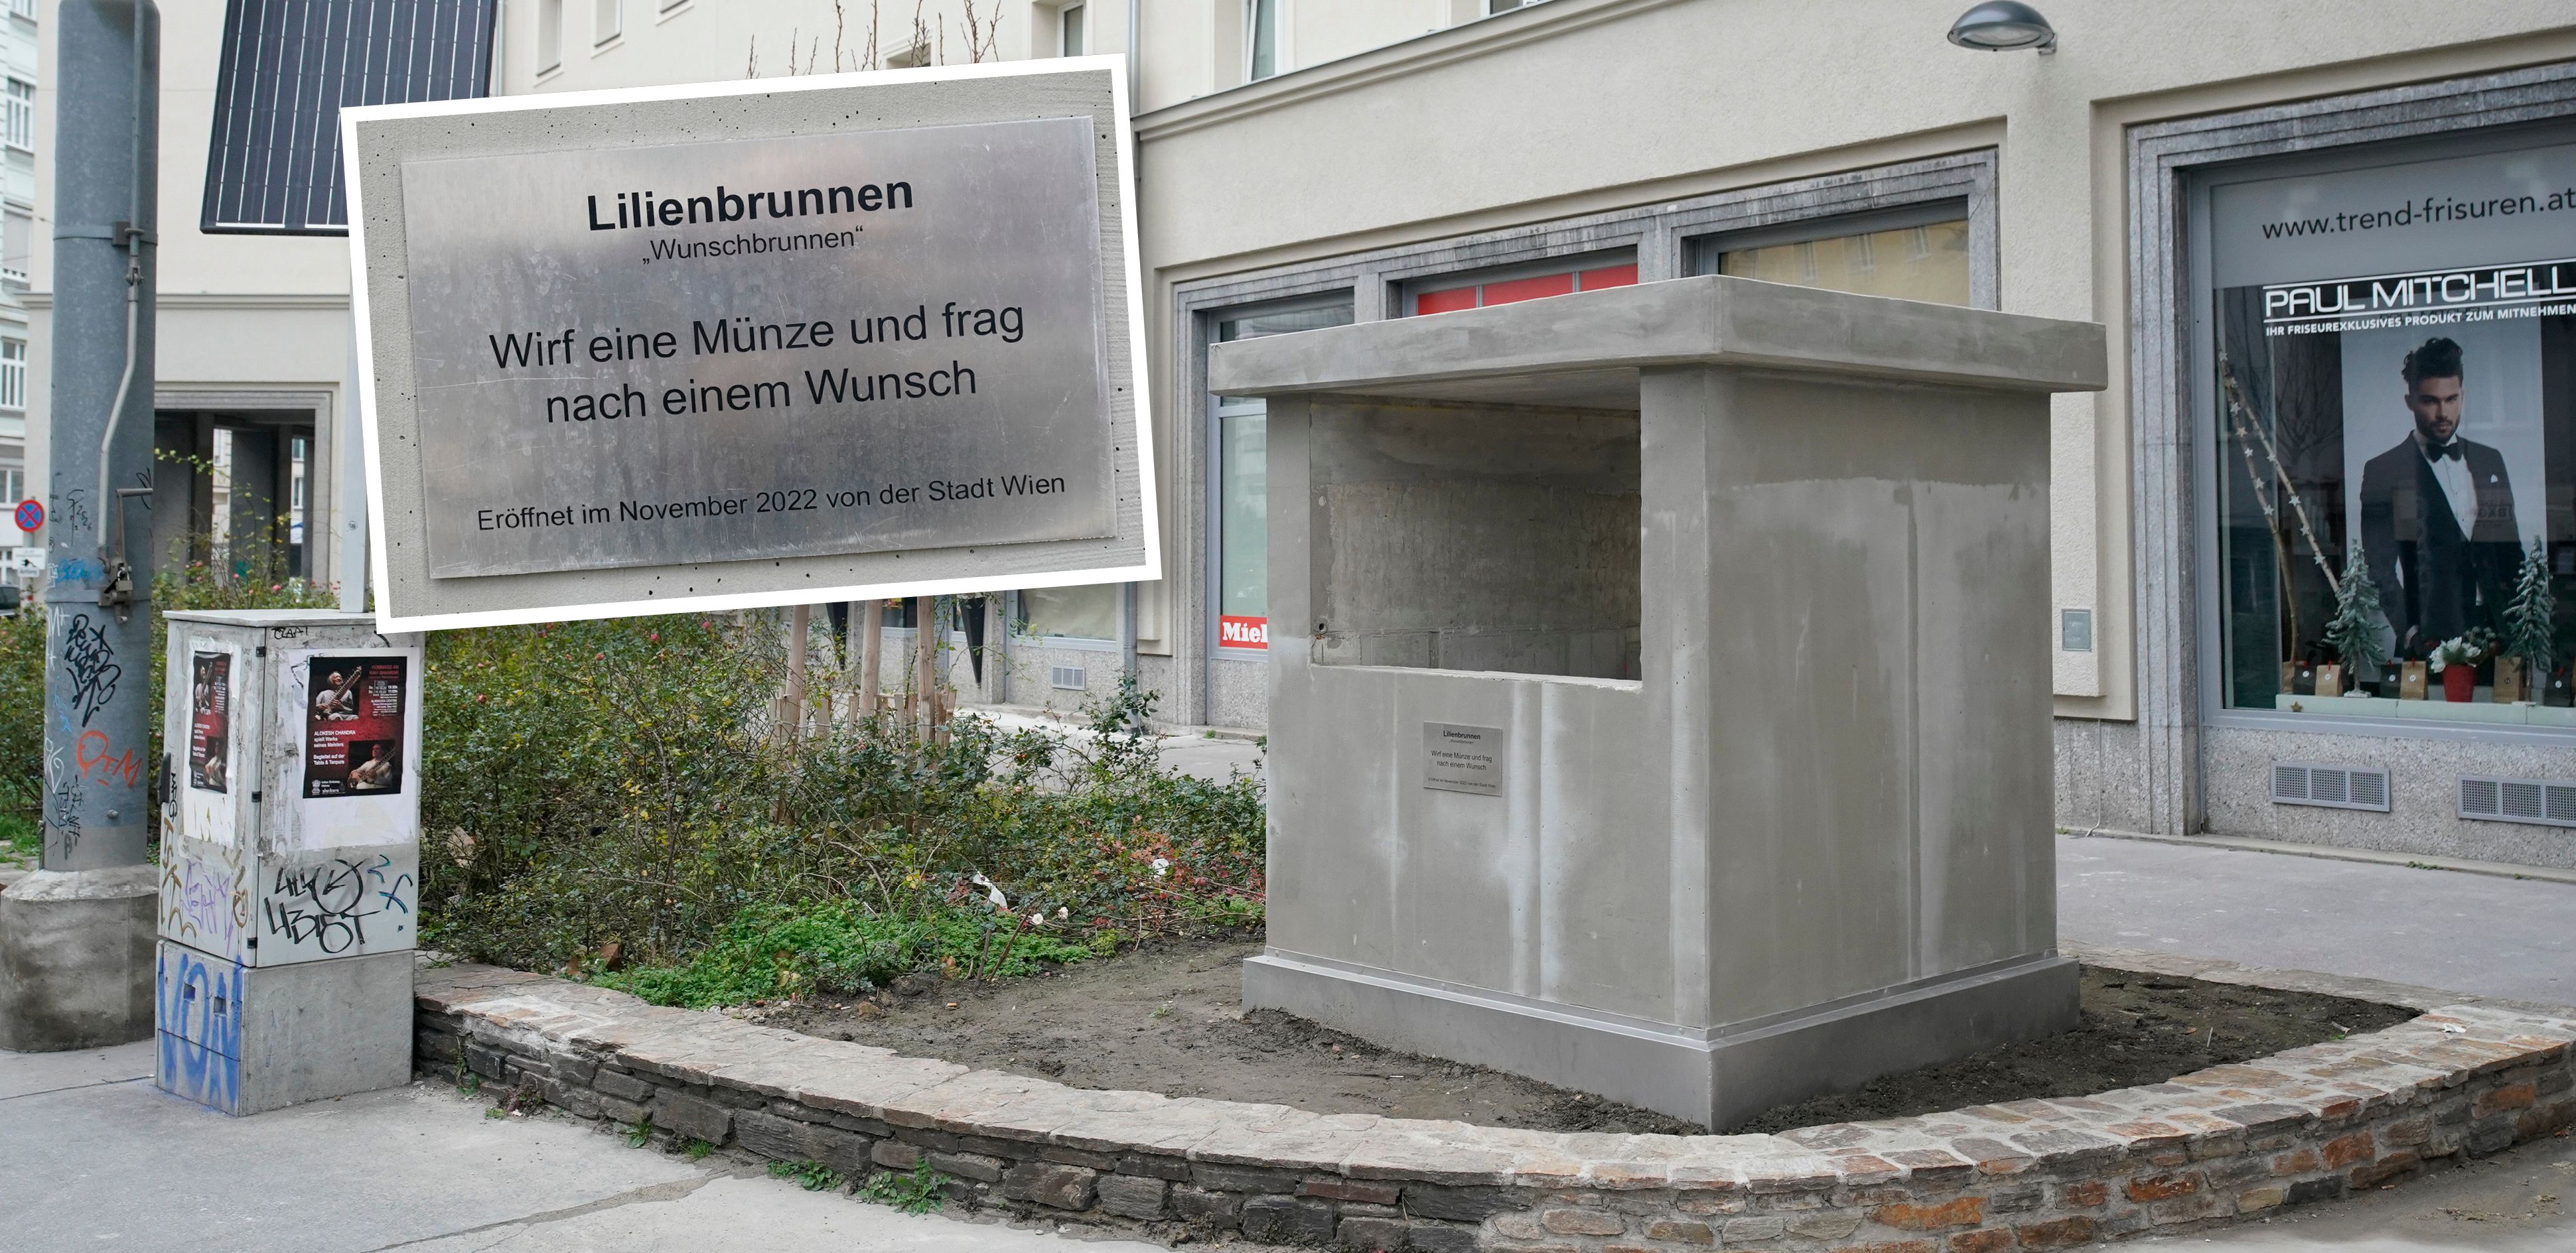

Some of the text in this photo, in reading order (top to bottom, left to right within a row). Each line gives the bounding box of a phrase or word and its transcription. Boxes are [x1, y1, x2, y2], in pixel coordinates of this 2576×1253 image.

[587, 182, 913, 232] Lilienbrunnen
[2262, 188, 2576, 239] www.trend-frisuren.at
[642, 225, 864, 265] „Wunschbrunnen“
[2265, 266, 2576, 318] PAUL MITCHELL
[488, 301, 1024, 369] Wirf eine Münze und frag
[2265, 304, 2576, 337] IHR FRISEUREXKLUSIVES PRODUKT ZUM MITNEHMEN
[547, 360, 976, 423] nach einem Wunsch
[477, 474, 1065, 531] Eröffnet im November 2022 von der Stadt Wien
[1443, 730, 1481, 740] Lilienbrunnen
